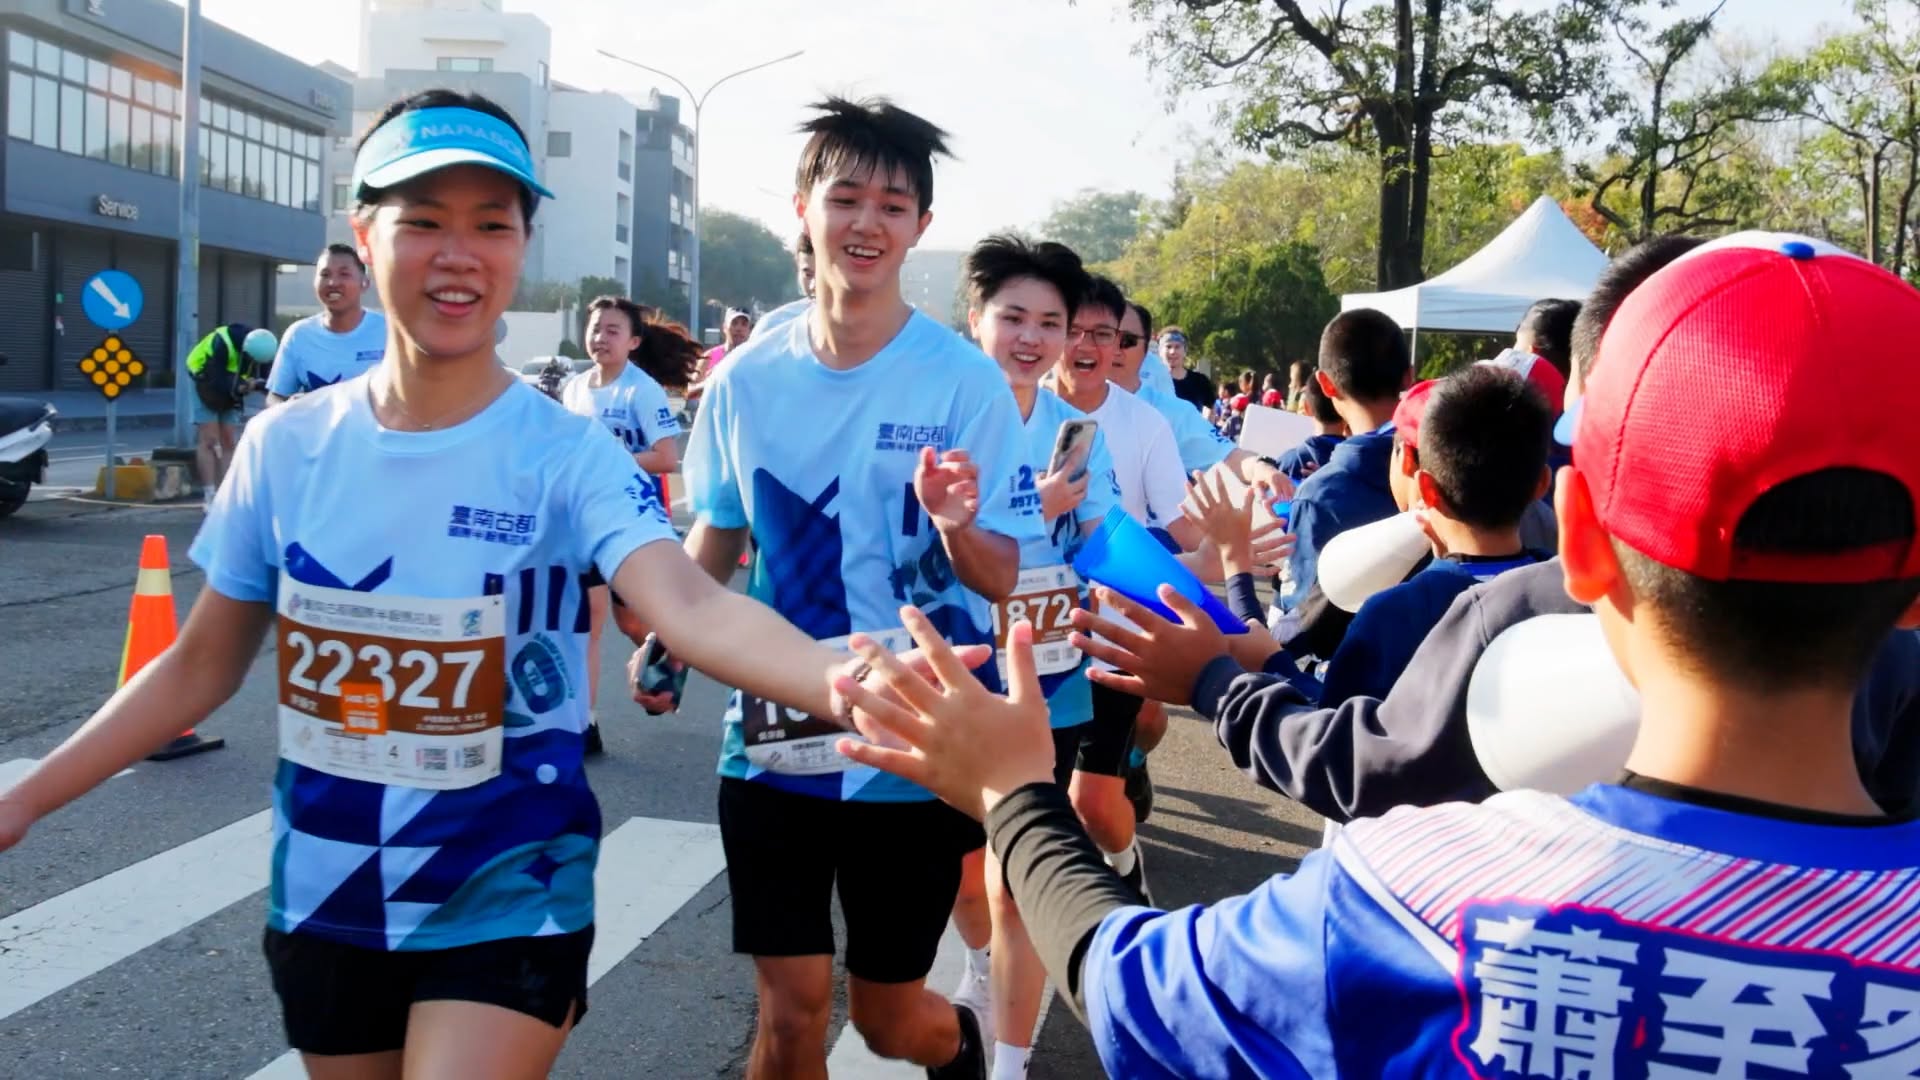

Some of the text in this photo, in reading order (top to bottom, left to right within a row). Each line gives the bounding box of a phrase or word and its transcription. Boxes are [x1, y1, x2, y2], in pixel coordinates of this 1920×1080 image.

[99, 194, 139, 220] Service
[878, 423, 946, 442] 臺南古都
[450, 505, 536, 533] 臺南古都
[287, 631, 485, 709] 22327
